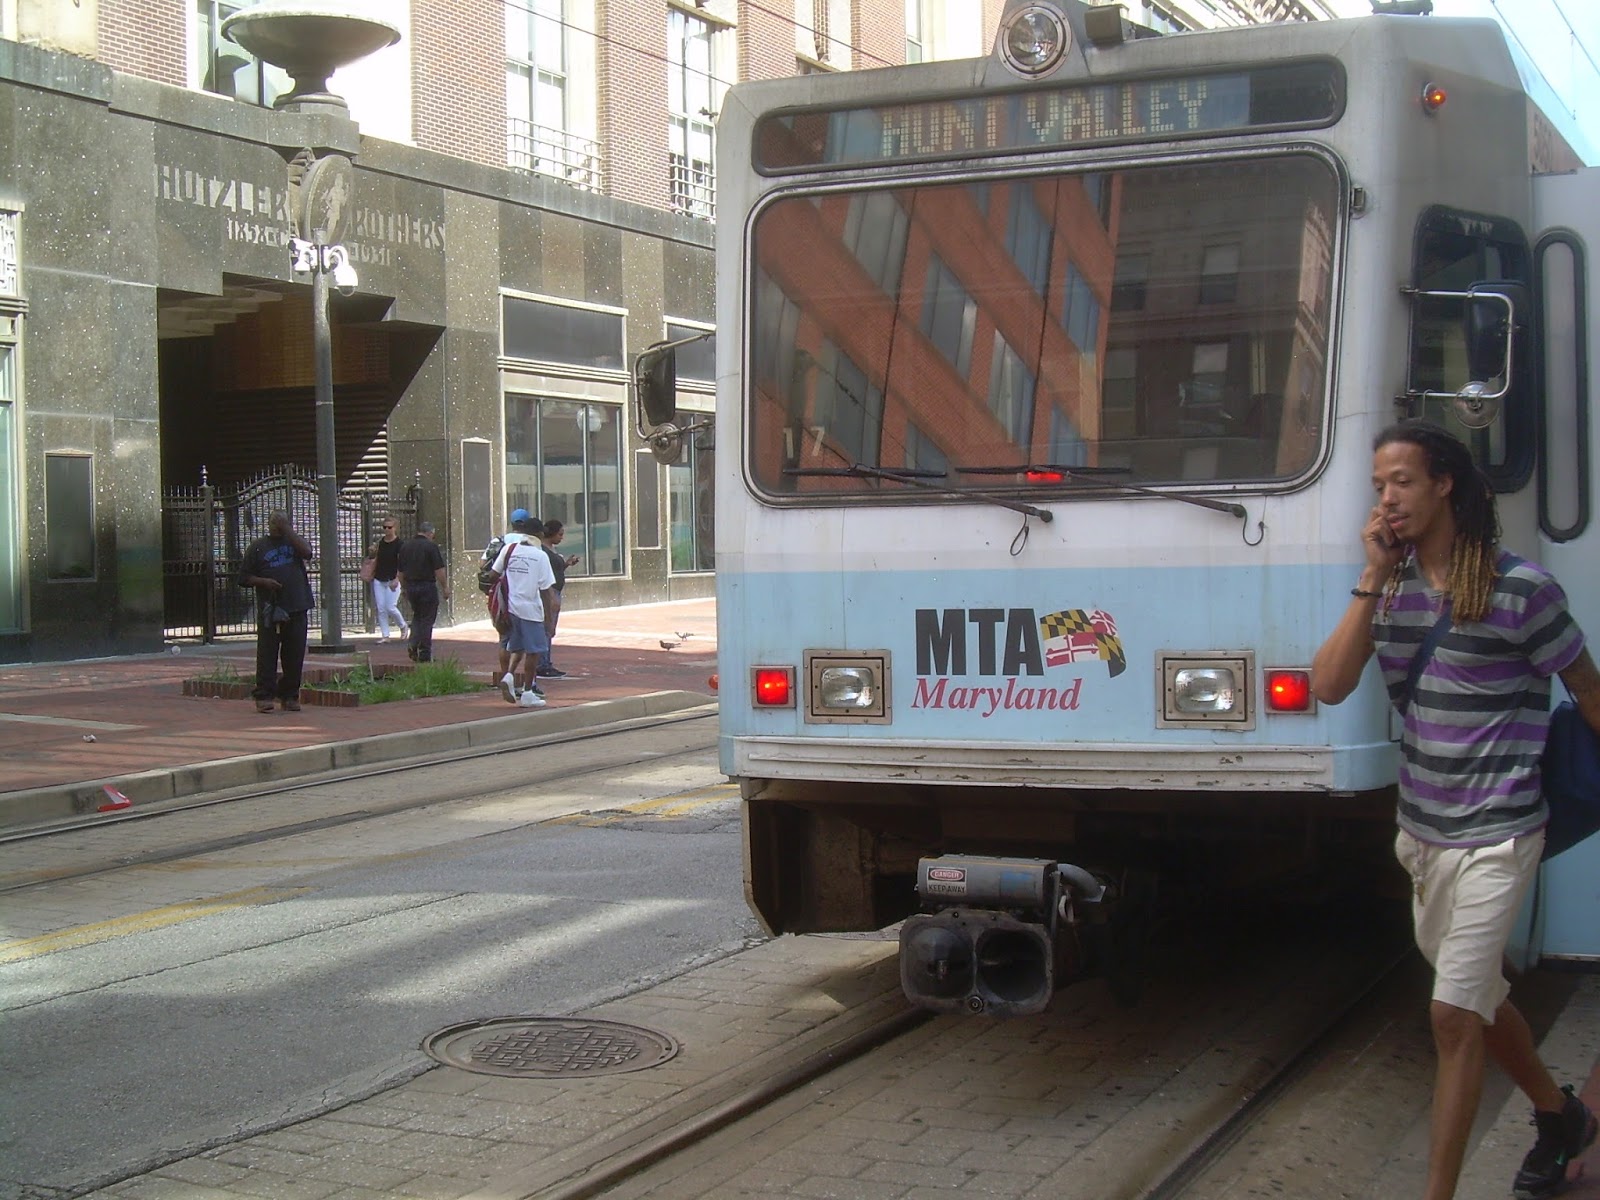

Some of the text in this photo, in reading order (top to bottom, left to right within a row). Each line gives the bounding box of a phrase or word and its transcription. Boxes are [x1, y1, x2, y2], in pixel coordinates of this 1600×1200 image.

[882, 78, 1207, 156] HUNT VALLEY
[915, 608, 1045, 676] MTA
[911, 677, 1083, 718] Maryland
[928, 884, 965, 894] KEEP AWAY
[934, 871, 959, 879] DANGER
